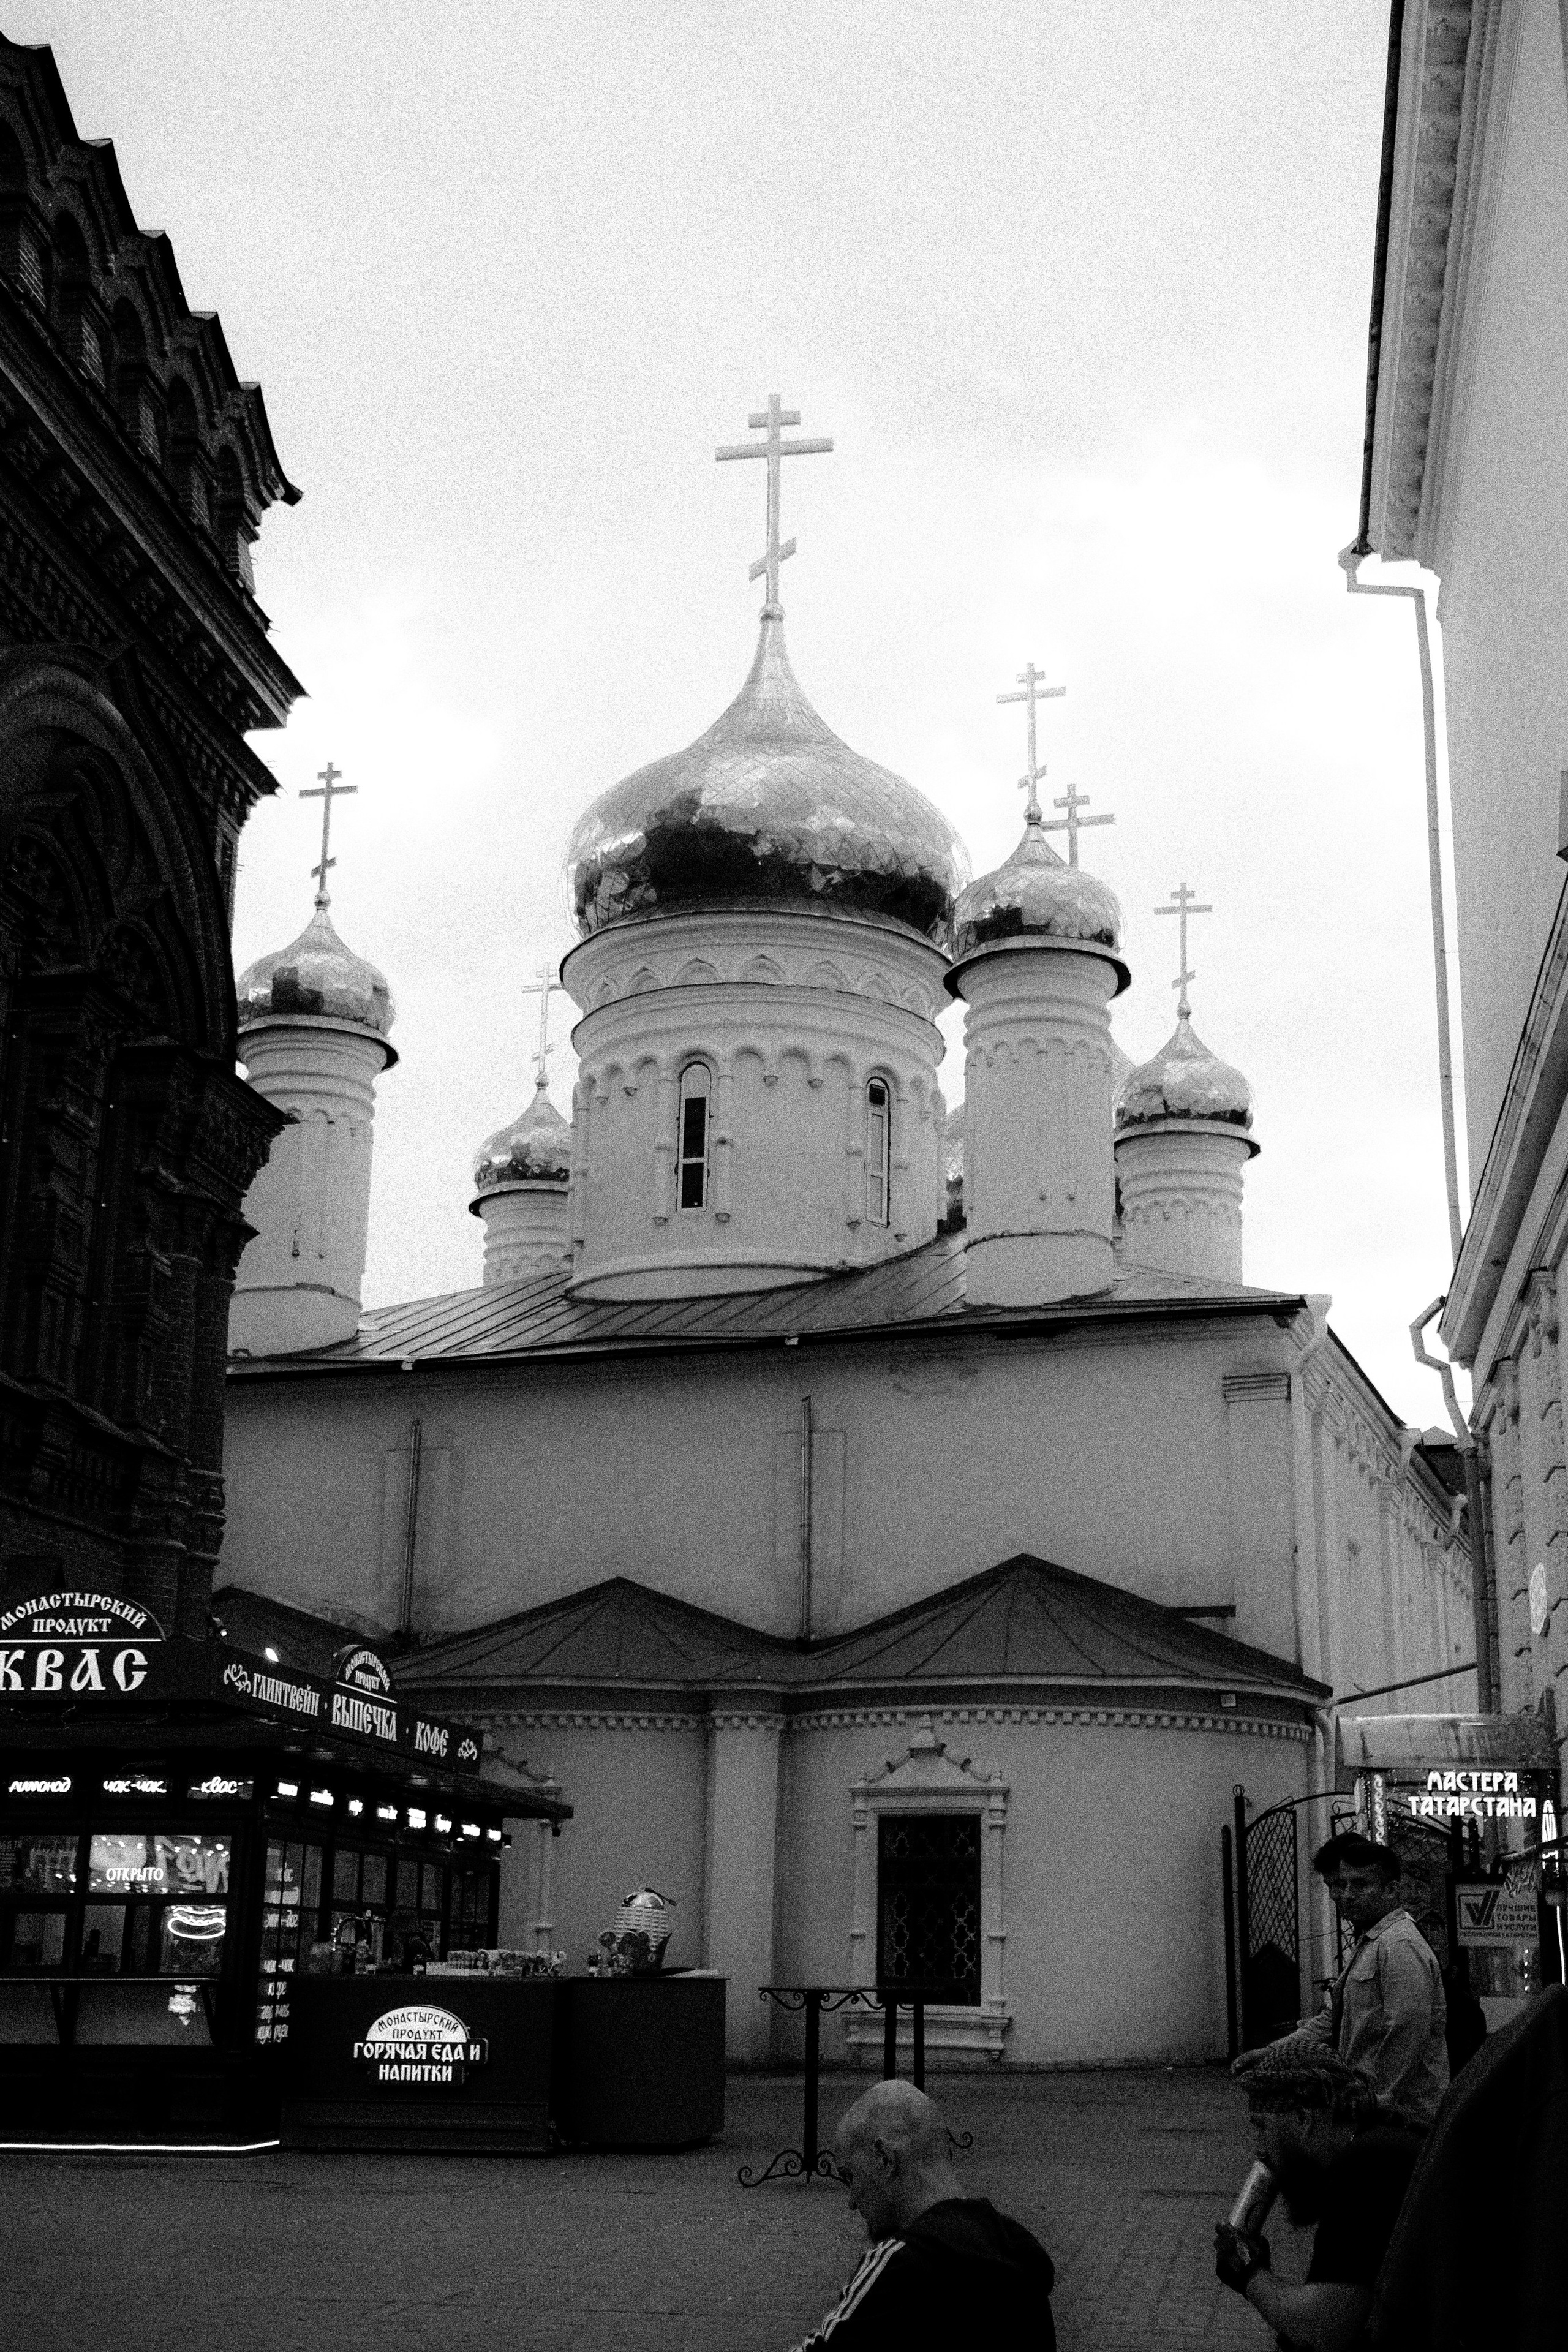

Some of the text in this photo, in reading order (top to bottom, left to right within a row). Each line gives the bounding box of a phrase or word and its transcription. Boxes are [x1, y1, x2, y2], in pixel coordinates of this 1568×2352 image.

[1, 1593, 147, 1630] МОНАСТЫРСКИЙ
[32, 1618, 111, 1636] ПРОДУКТ
[0, 1649, 148, 1691] КВАС
[331, 1694, 397, 1741] ВЫПЕЧКА
[415, 1721, 448, 1757] КОФЕ
[9, 1777, 72, 1792] лимонад
[103, 1780, 167, 1792] чак-чак
[201, 1776, 238, 1793] квас
[1427, 1771, 1518, 1792] МАСТЕРА
[1408, 1796, 1536, 1817] ТАТАРСТАНА
[106, 1867, 164, 1882] ОТКРЫТО
[377, 2012, 459, 2034] МОНАСТЫРСКИЙ
[393, 2029, 442, 2040] ПРОДУКТ
[353, 2042, 428, 2059] ГОРЯЧАЯ
[469, 2044, 480, 2060] И
[379, 2064, 453, 2081] НАПИТКИ
